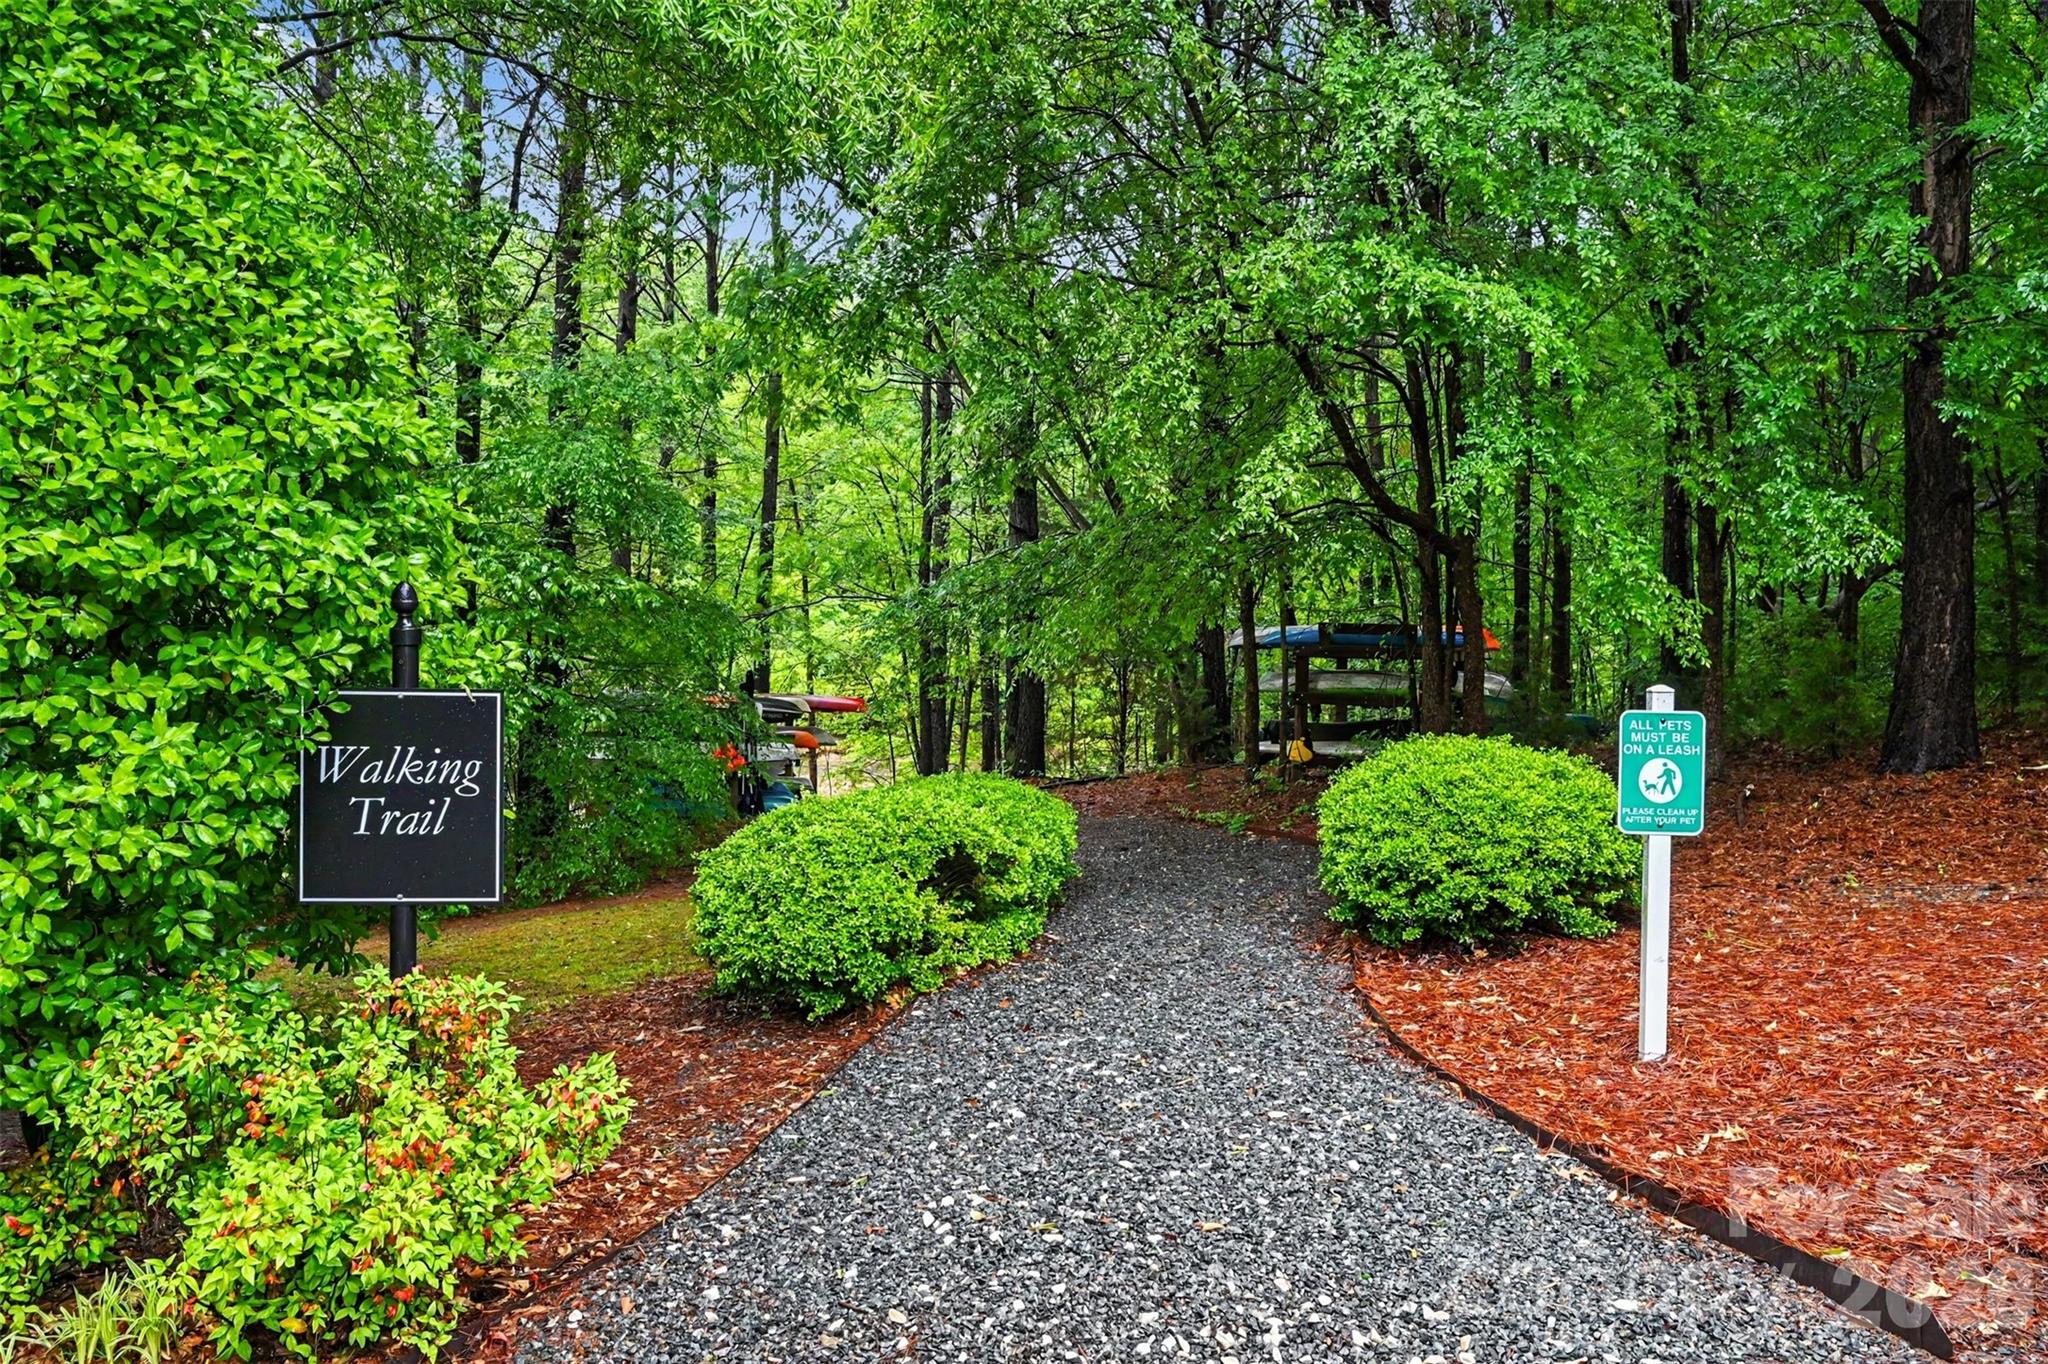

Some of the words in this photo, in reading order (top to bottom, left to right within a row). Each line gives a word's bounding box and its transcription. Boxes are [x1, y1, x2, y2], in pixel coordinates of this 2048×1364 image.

[1629, 720, 1653, 730] ALL
[1659, 720, 1692, 731] PETS
[1631, 732, 1666, 743] MUST
[1672, 733, 1689, 743] BE
[1623, 744, 1642, 754] ON
[1645, 745, 1655, 754] A
[1658, 745, 1700, 755] LEASH
[318, 745, 482, 797] Walking
[349, 797, 451, 836] Trail
[1622, 807, 1654, 815] PLEASE
[1657, 808, 1685, 816] CLEAN
